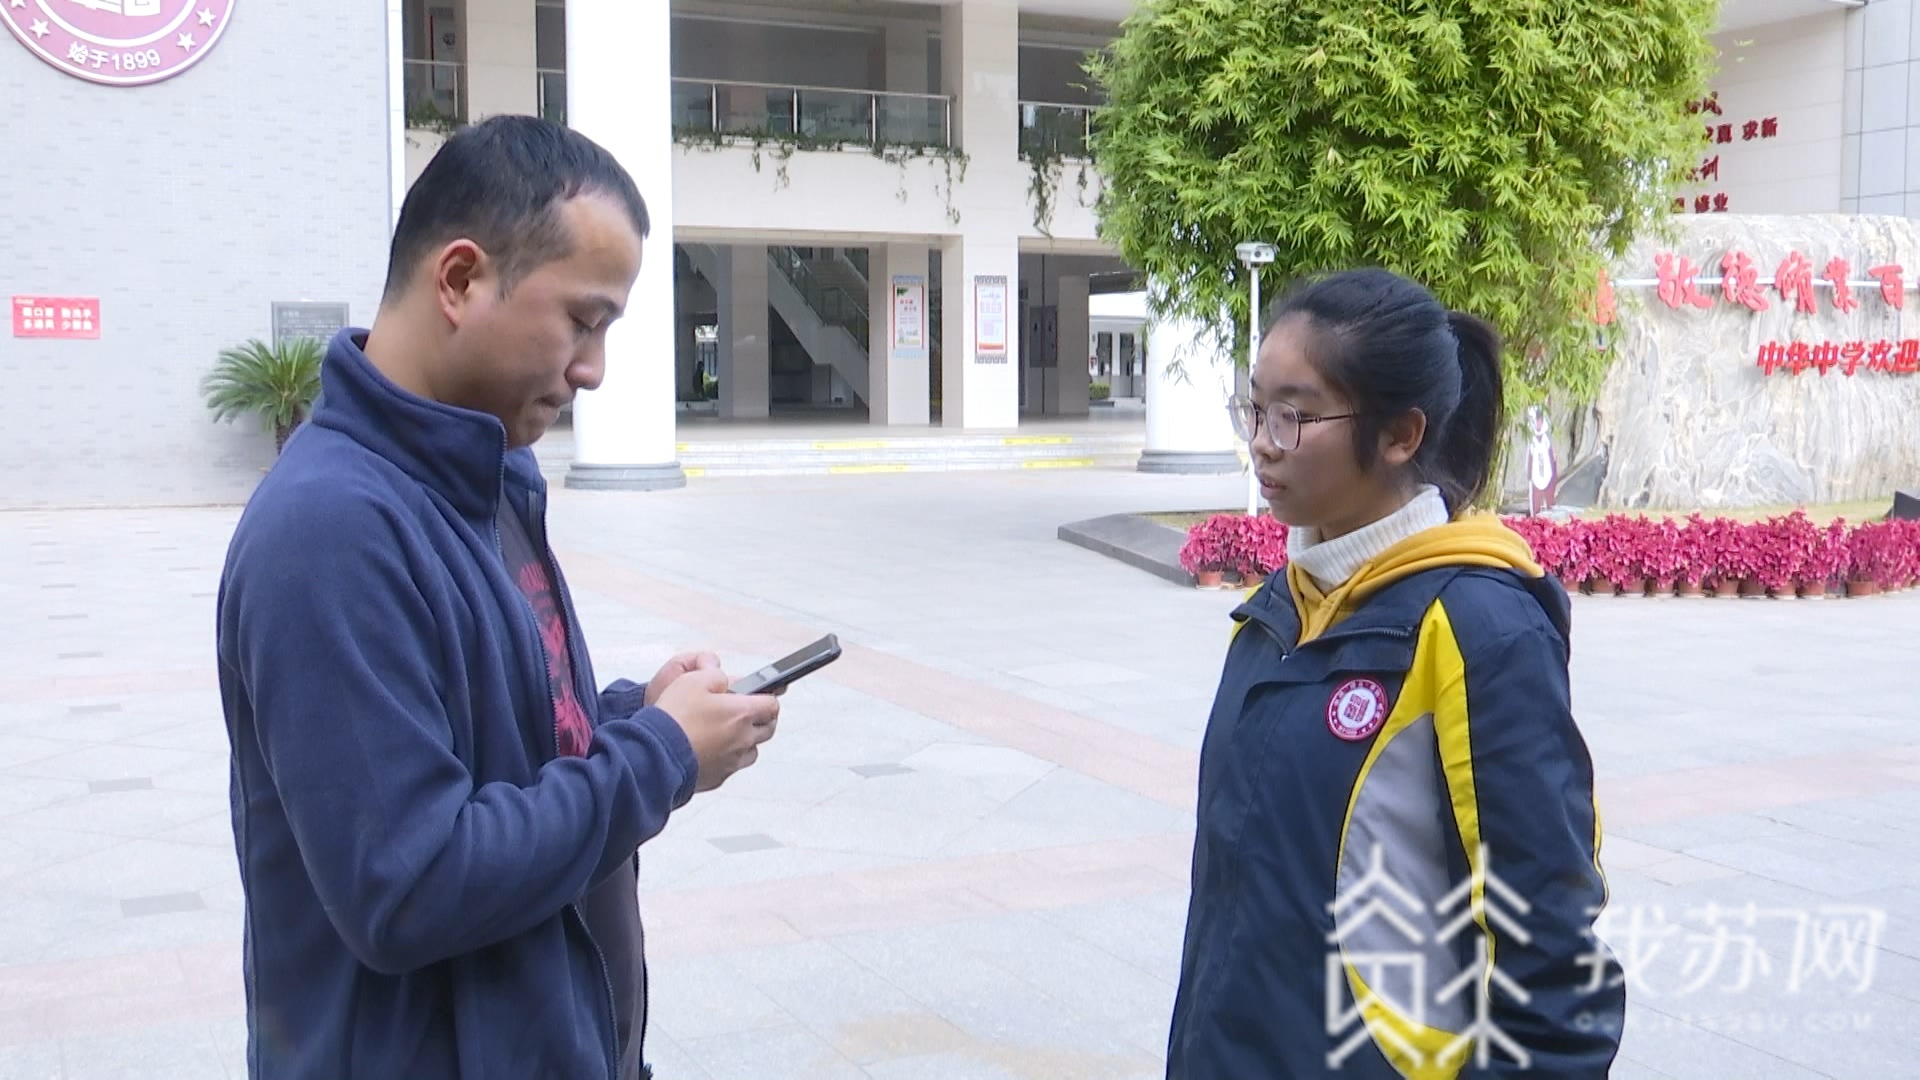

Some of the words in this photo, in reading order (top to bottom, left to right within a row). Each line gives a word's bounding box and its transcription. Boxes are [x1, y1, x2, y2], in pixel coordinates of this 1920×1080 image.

[66, 41, 161, 71] 始于1899
[1757, 338, 1920, 377] 中华中学欢迎
